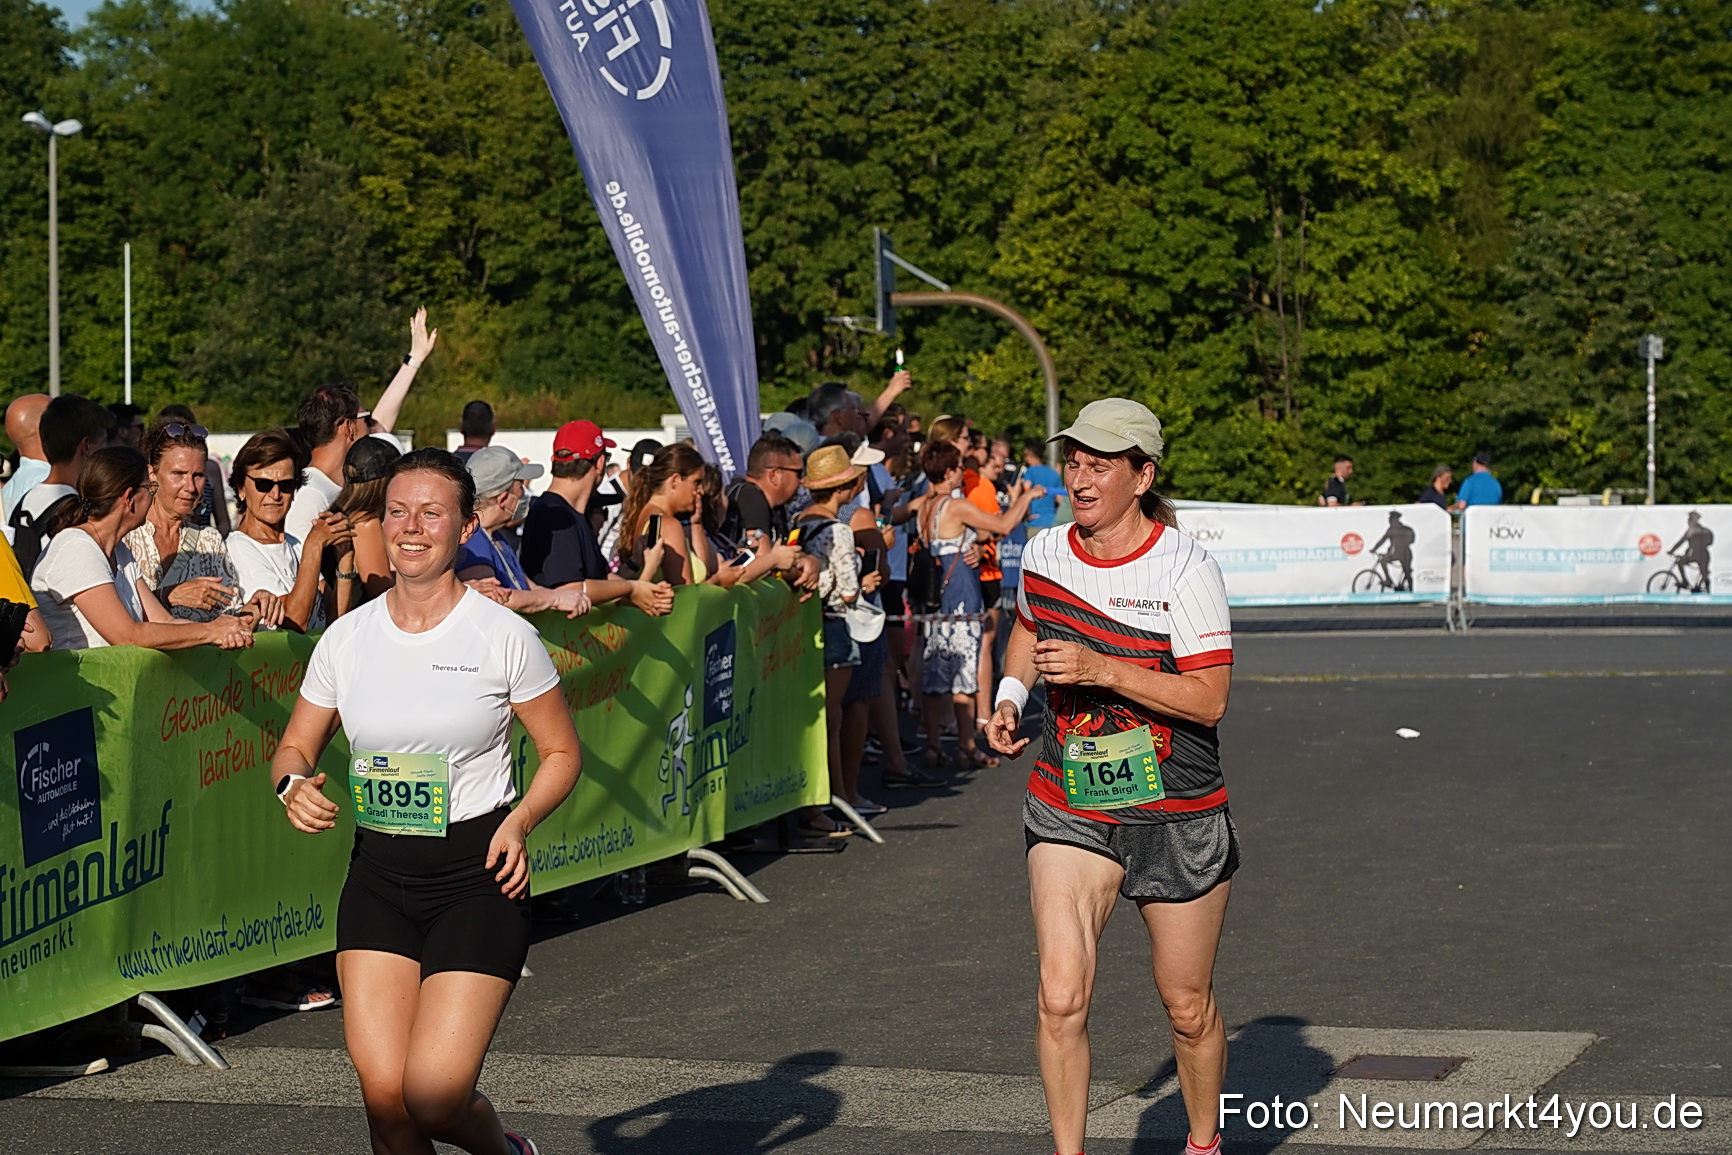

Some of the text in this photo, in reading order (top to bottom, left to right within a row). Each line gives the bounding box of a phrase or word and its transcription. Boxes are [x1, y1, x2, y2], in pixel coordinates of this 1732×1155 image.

[1489, 527, 1524, 540] NOW
[1491, 550, 1544, 563] E-BIKES
[1547, 550, 1558, 563] &
[1108, 596, 1162, 611] NEUMARKT
[431, 664, 479, 673] Theresa Gradl
[160, 667, 245, 742] Gesunde
[199, 728, 256, 789] laufen
[369, 766, 400, 774] Firmenlauf
[1082, 758, 1134, 786] 164
[31, 757, 82, 793] Fischer
[1067, 769, 1078, 795] RUN
[1143, 756, 1158, 791] 2022
[37, 780, 78, 805] AUTOMOBILE
[353, 785, 365, 812] RUN
[363, 779, 431, 808] 1895
[1084, 783, 1139, 796] Frank Birgit
[366, 806, 429, 820] Gradl Theresa
[433, 786, 443, 824] 2022
[117, 893, 325, 980] www.firmenlauf-oberpfalz.de
[1, 921, 75, 980] neumarkt
